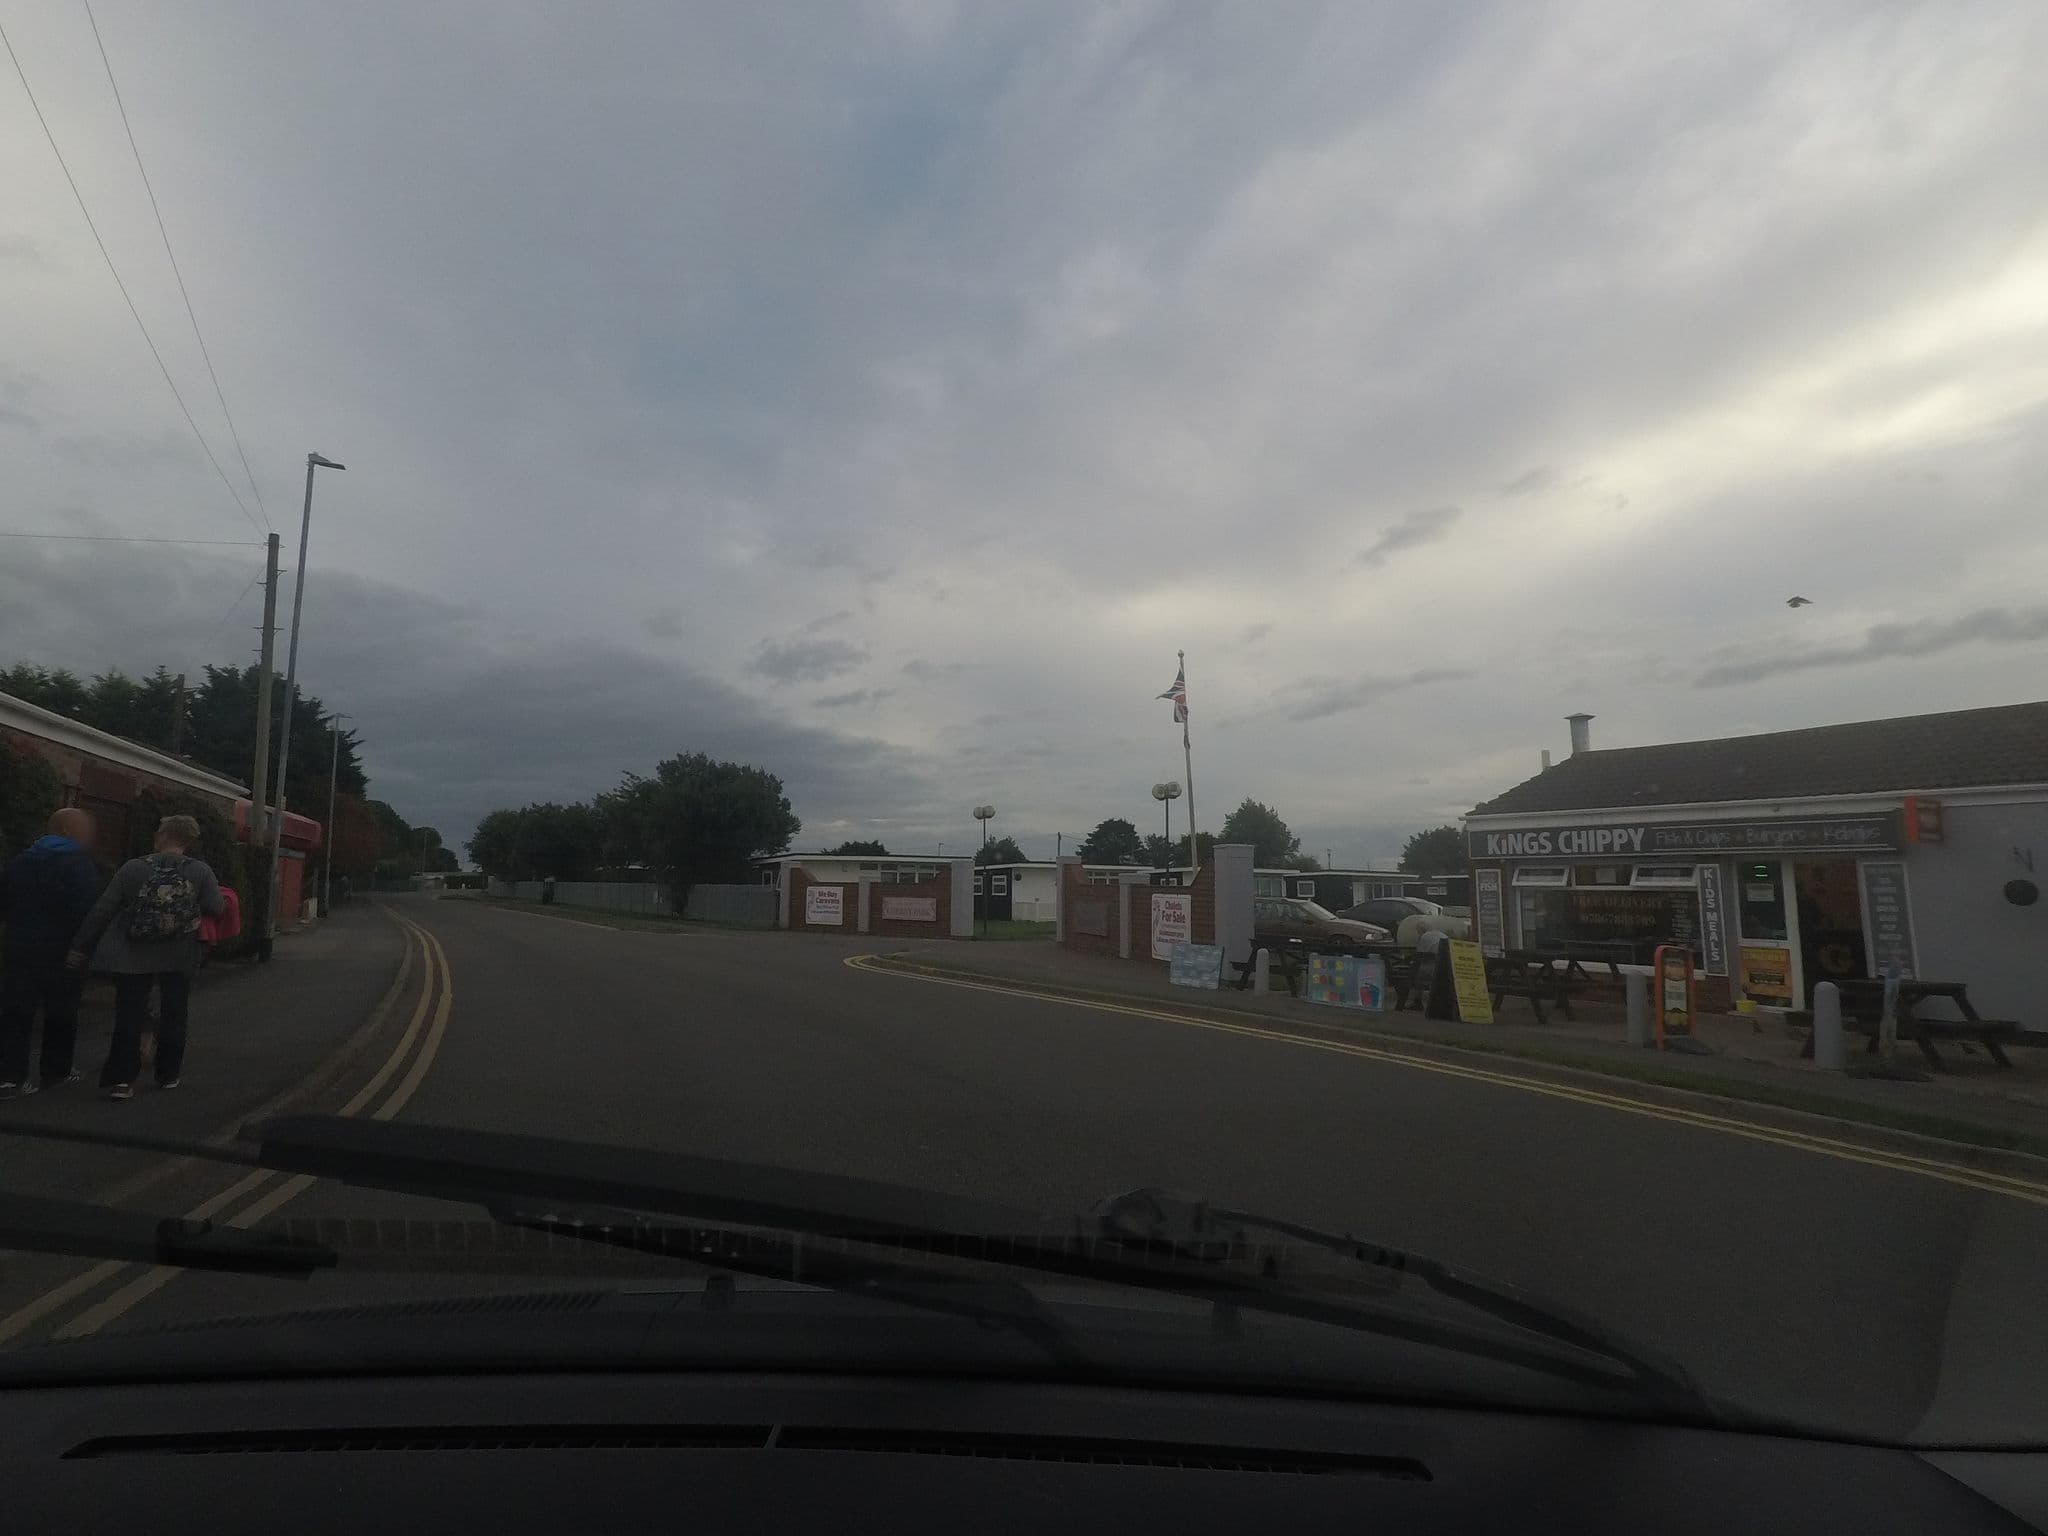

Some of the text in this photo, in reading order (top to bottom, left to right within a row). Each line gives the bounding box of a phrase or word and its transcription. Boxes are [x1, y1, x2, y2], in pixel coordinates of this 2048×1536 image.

[1487, 828, 1645, 855] KINGS CHIPPY
[1746, 828, 1807, 845] Burgers
[1162, 910, 1186, 923] For Sale
[1704, 868, 1720, 961] KIDS MEALS
